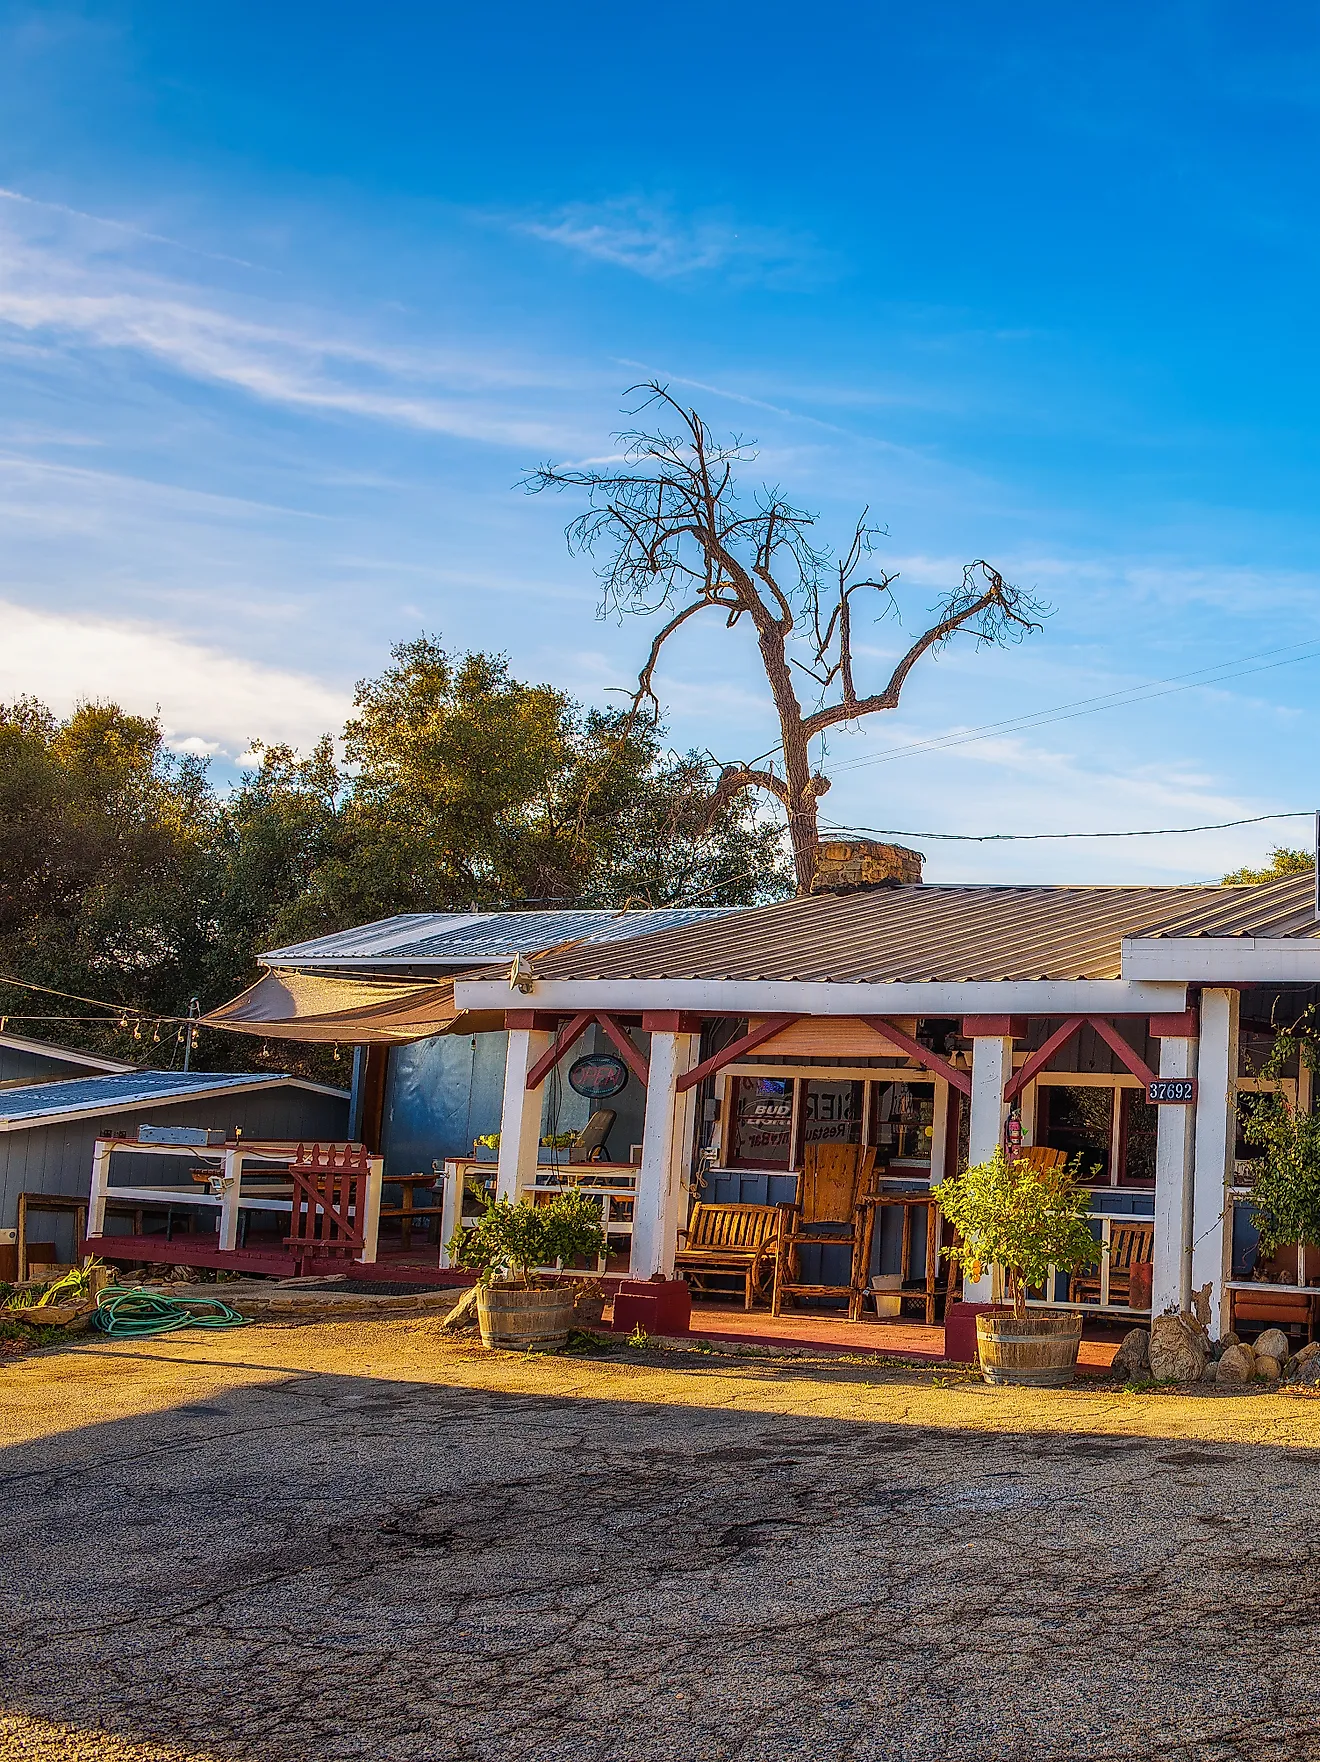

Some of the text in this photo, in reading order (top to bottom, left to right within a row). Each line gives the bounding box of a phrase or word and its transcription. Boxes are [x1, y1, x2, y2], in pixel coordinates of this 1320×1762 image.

[573, 1065, 622, 1086] OPEN
[1149, 1083, 1192, 1099] 37692
[754, 1104, 791, 1115] BUD
